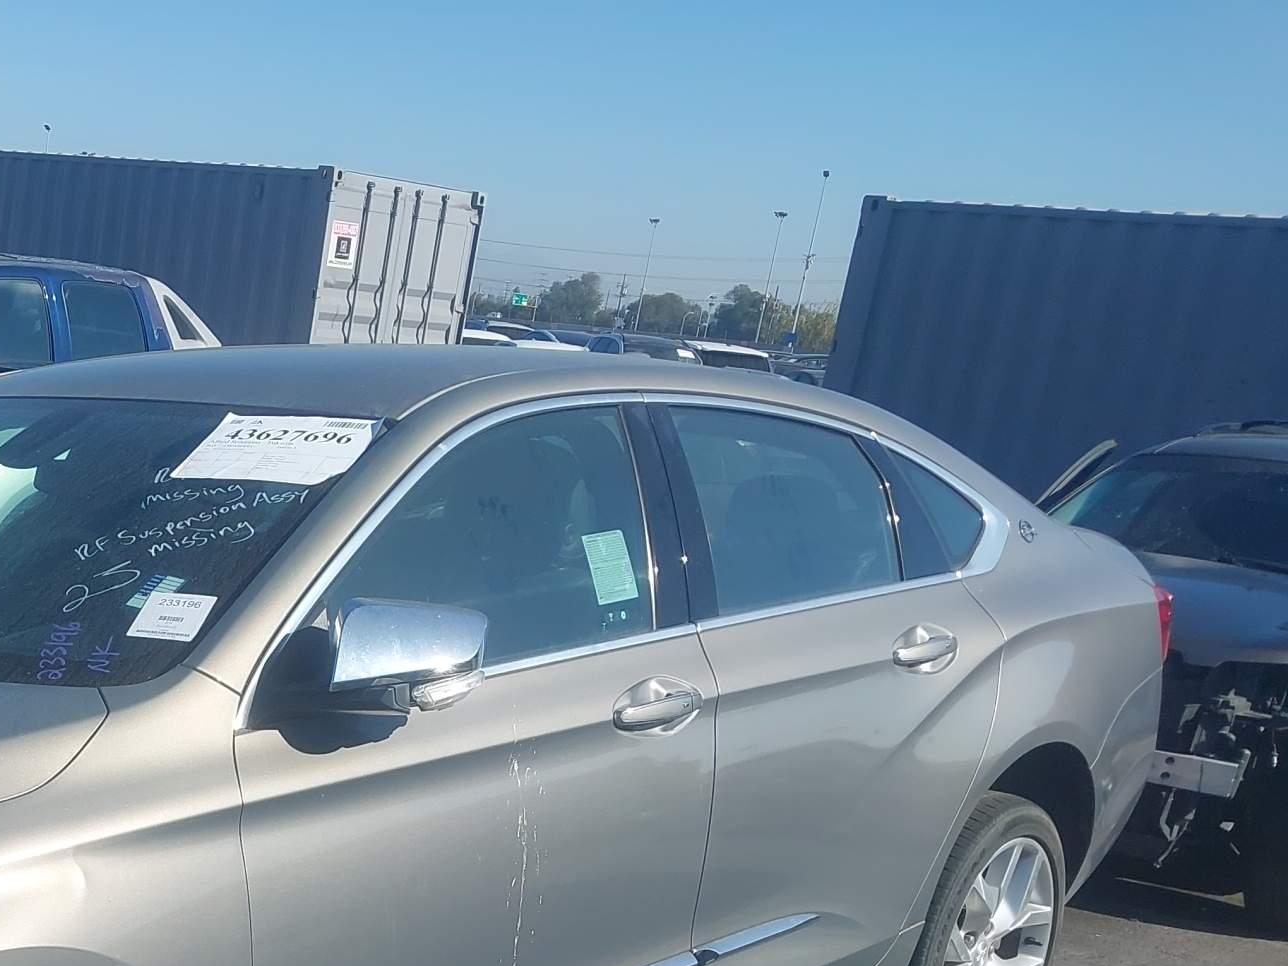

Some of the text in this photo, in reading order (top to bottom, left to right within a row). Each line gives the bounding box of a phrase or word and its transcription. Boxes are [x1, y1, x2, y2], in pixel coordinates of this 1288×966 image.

[225, 428, 353, 445] 43627696
[158, 598, 202, 609] 233196
[37, 622, 81, 680] 233196
